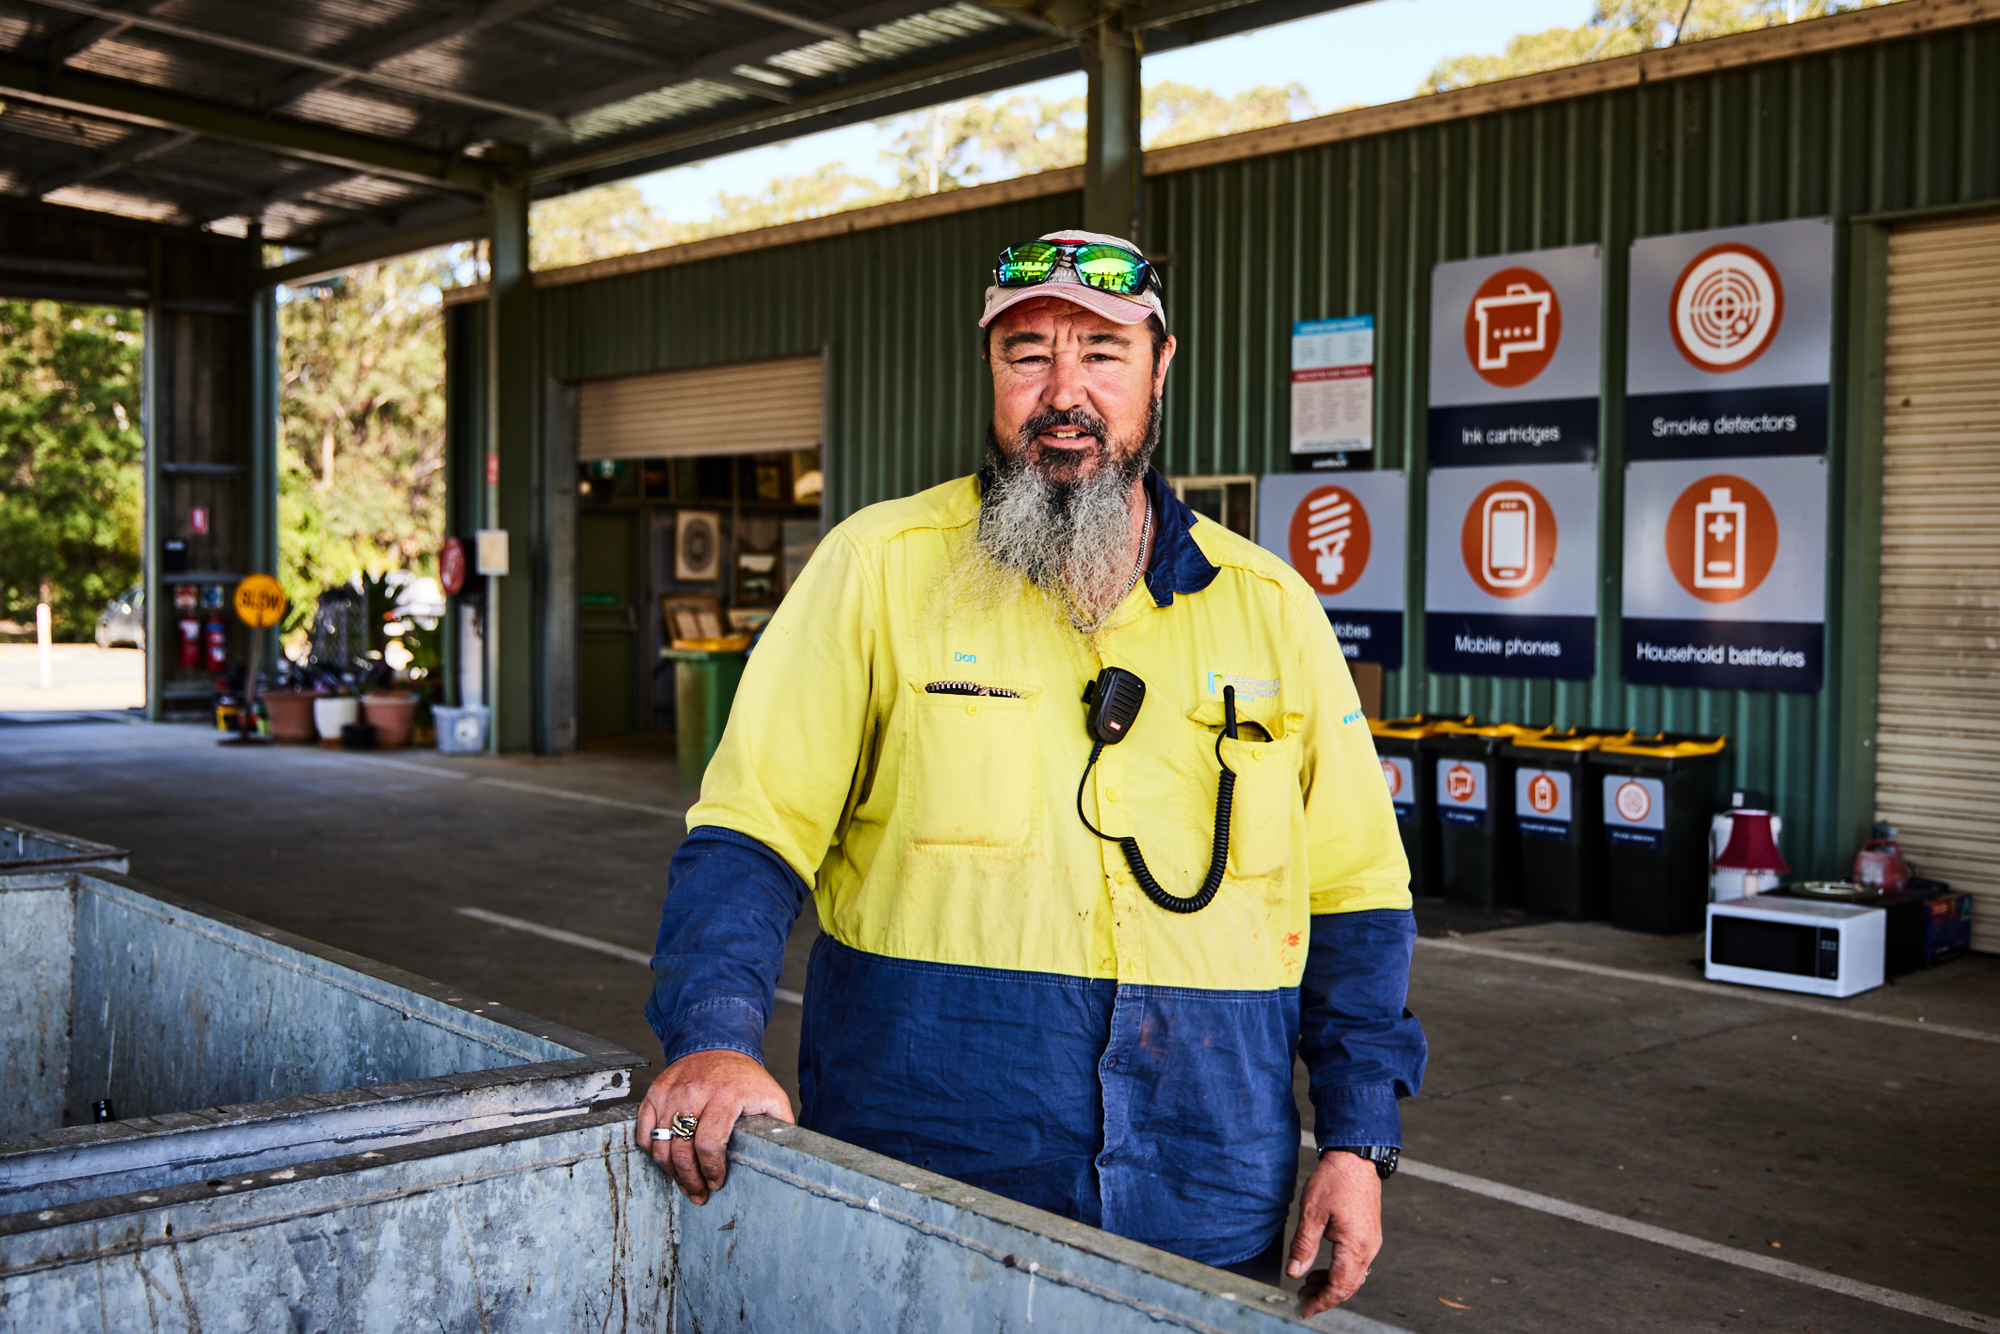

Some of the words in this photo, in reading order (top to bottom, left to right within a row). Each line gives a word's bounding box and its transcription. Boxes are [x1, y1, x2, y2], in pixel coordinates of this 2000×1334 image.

[1462, 427, 1484, 445] Ink
[1486, 425, 1561, 446] cartridges
[1652, 416, 1711, 437] Smoke
[1714, 414, 1798, 434] detectors
[241, 590, 280, 610] SLOW
[1455, 634, 1502, 654] Mobile
[1505, 637, 1561, 658] phones
[1636, 642, 1725, 664] Household
[1728, 645, 1806, 668] batteries
[954, 651, 977, 664] Dan
[1225, 674, 1280, 689] RESOURCE
[1233, 685, 1280, 698] ECOVERY
